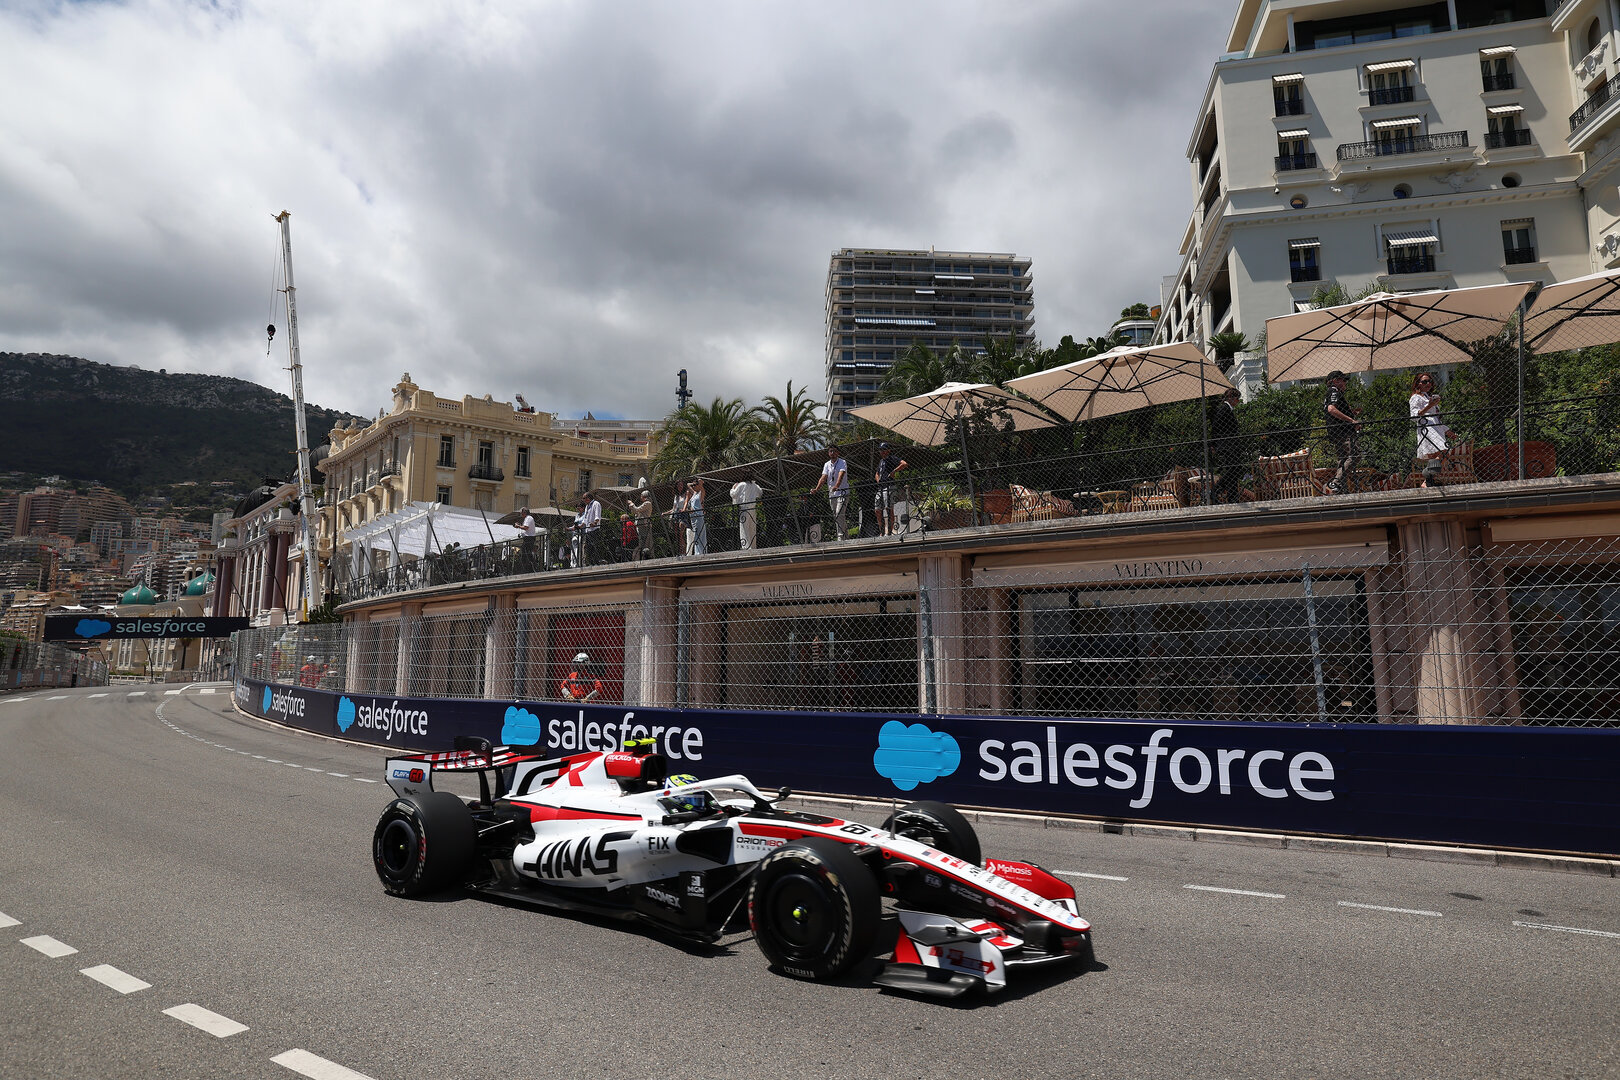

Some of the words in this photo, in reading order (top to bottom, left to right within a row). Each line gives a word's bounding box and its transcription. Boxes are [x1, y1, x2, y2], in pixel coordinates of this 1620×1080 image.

[1114, 558, 1203, 579] VALENTINO
[761, 583, 813, 598] VALENTINO
[115, 619, 205, 637] salesforce
[271, 688, 305, 721] salesforce
[357, 699, 428, 740] salesforce
[606, 754, 632, 762] RUCKUS
[409, 768, 424, 783] GO
[978, 726, 1335, 809] salesforce
[648, 836, 670, 850] FIX
[522, 830, 638, 879] HAAS
[772, 849, 822, 865] ZERO
[996, 863, 1032, 877] Mphasis
[645, 886, 681, 909] ZOOMEX
[784, 965, 815, 978] PIRELLI
